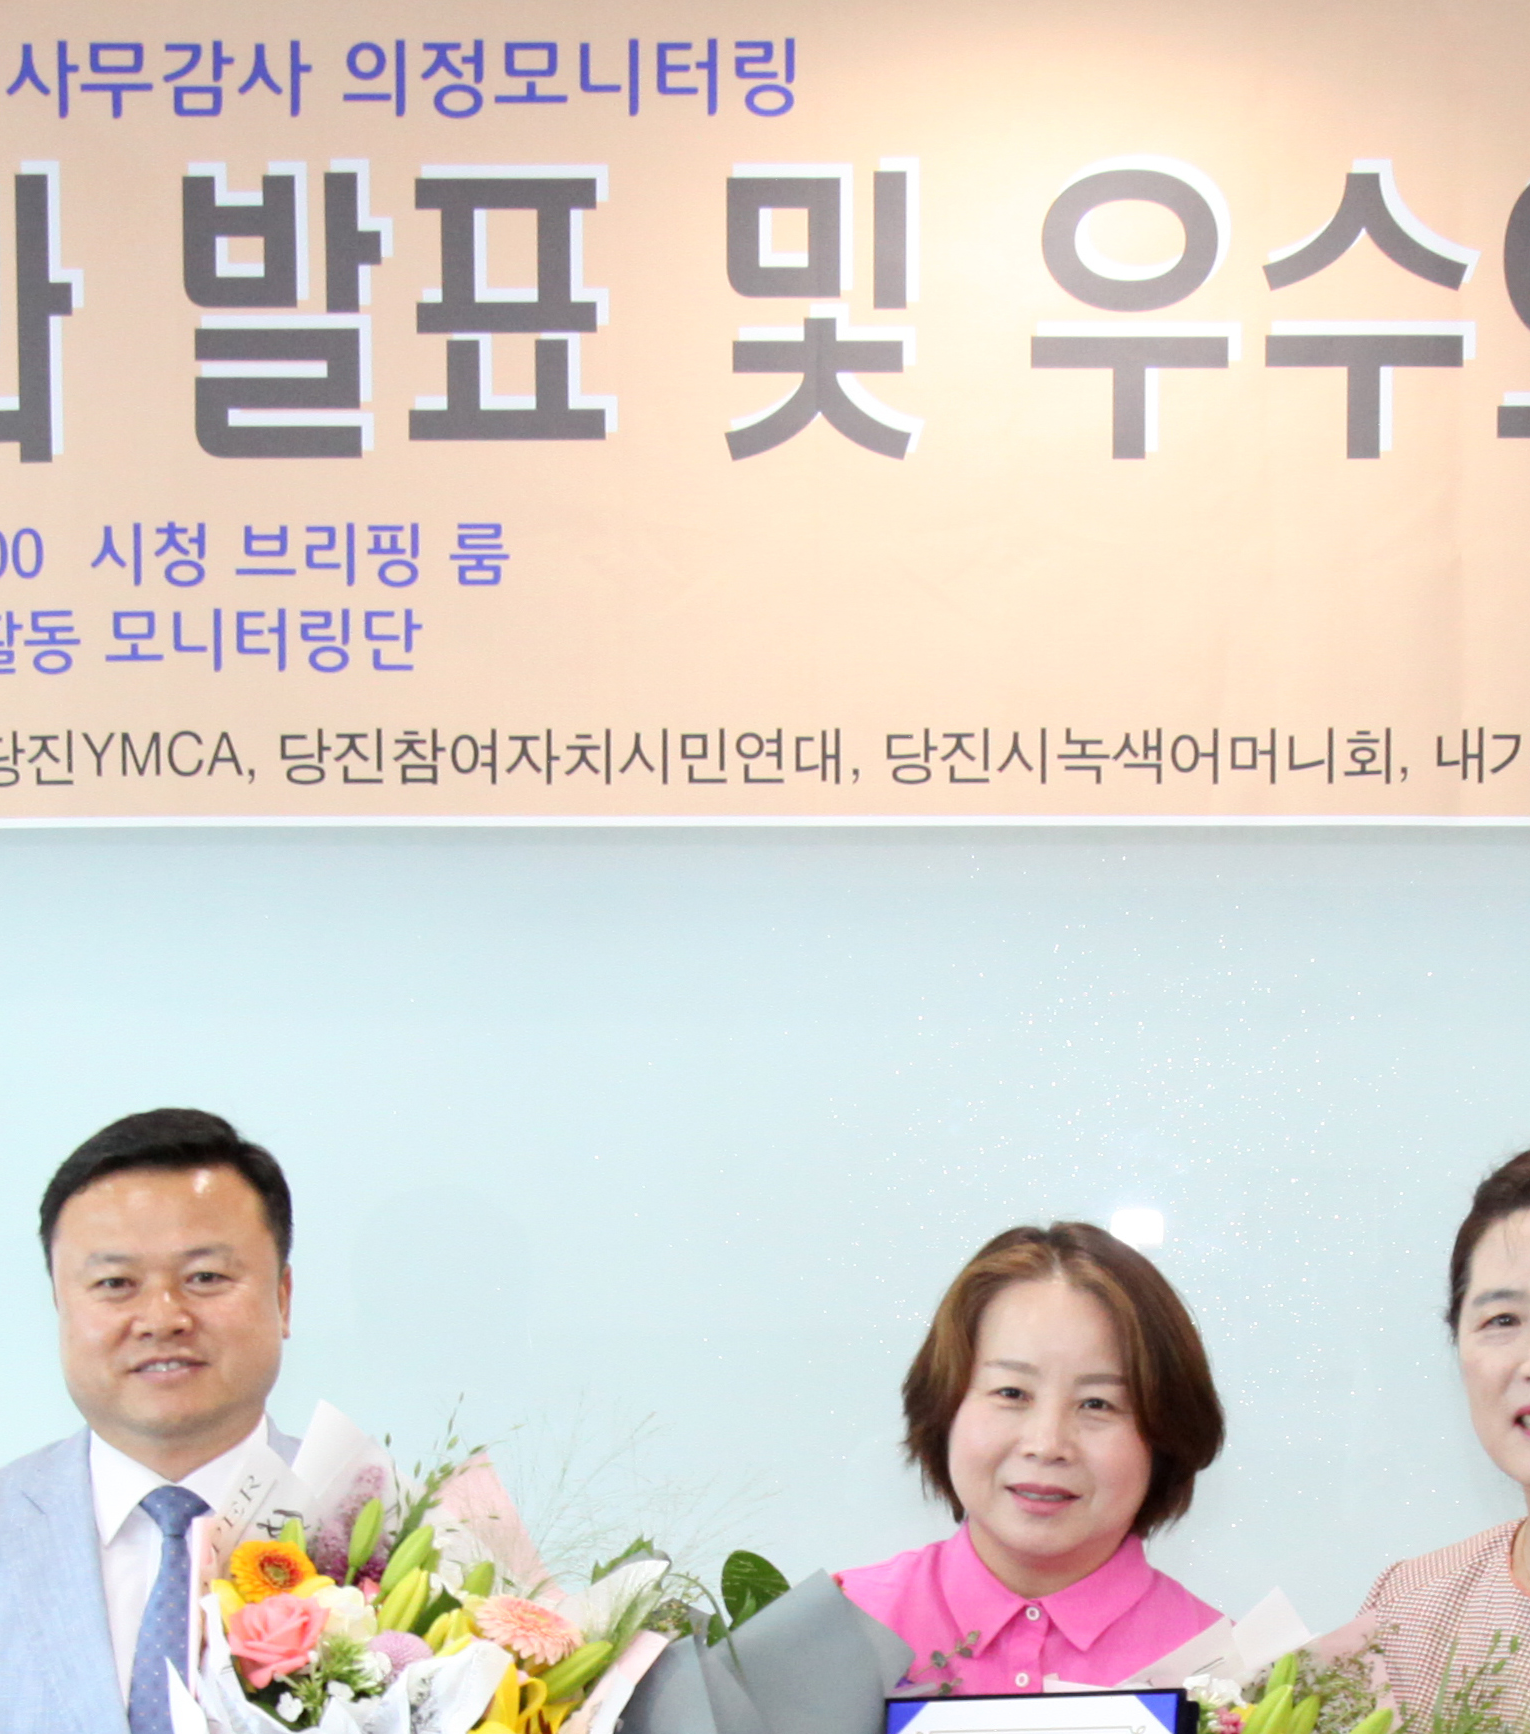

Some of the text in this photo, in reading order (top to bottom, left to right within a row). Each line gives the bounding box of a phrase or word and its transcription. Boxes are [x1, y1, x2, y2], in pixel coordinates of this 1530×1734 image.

[342, 36, 795, 119] 의정모니터링
[181, 171, 605, 459] 발표
[725, 171, 910, 460] 및
[91, 521, 206, 587] 시청
[235, 522, 419, 588] 브리핑
[450, 523, 509, 586] 룸
[105, 607, 423, 673] 모니터링단
[280, 728, 859, 785] 당진참여자치시민연대,
[887, 727, 1407, 784] 당진시녹색어머니회,
